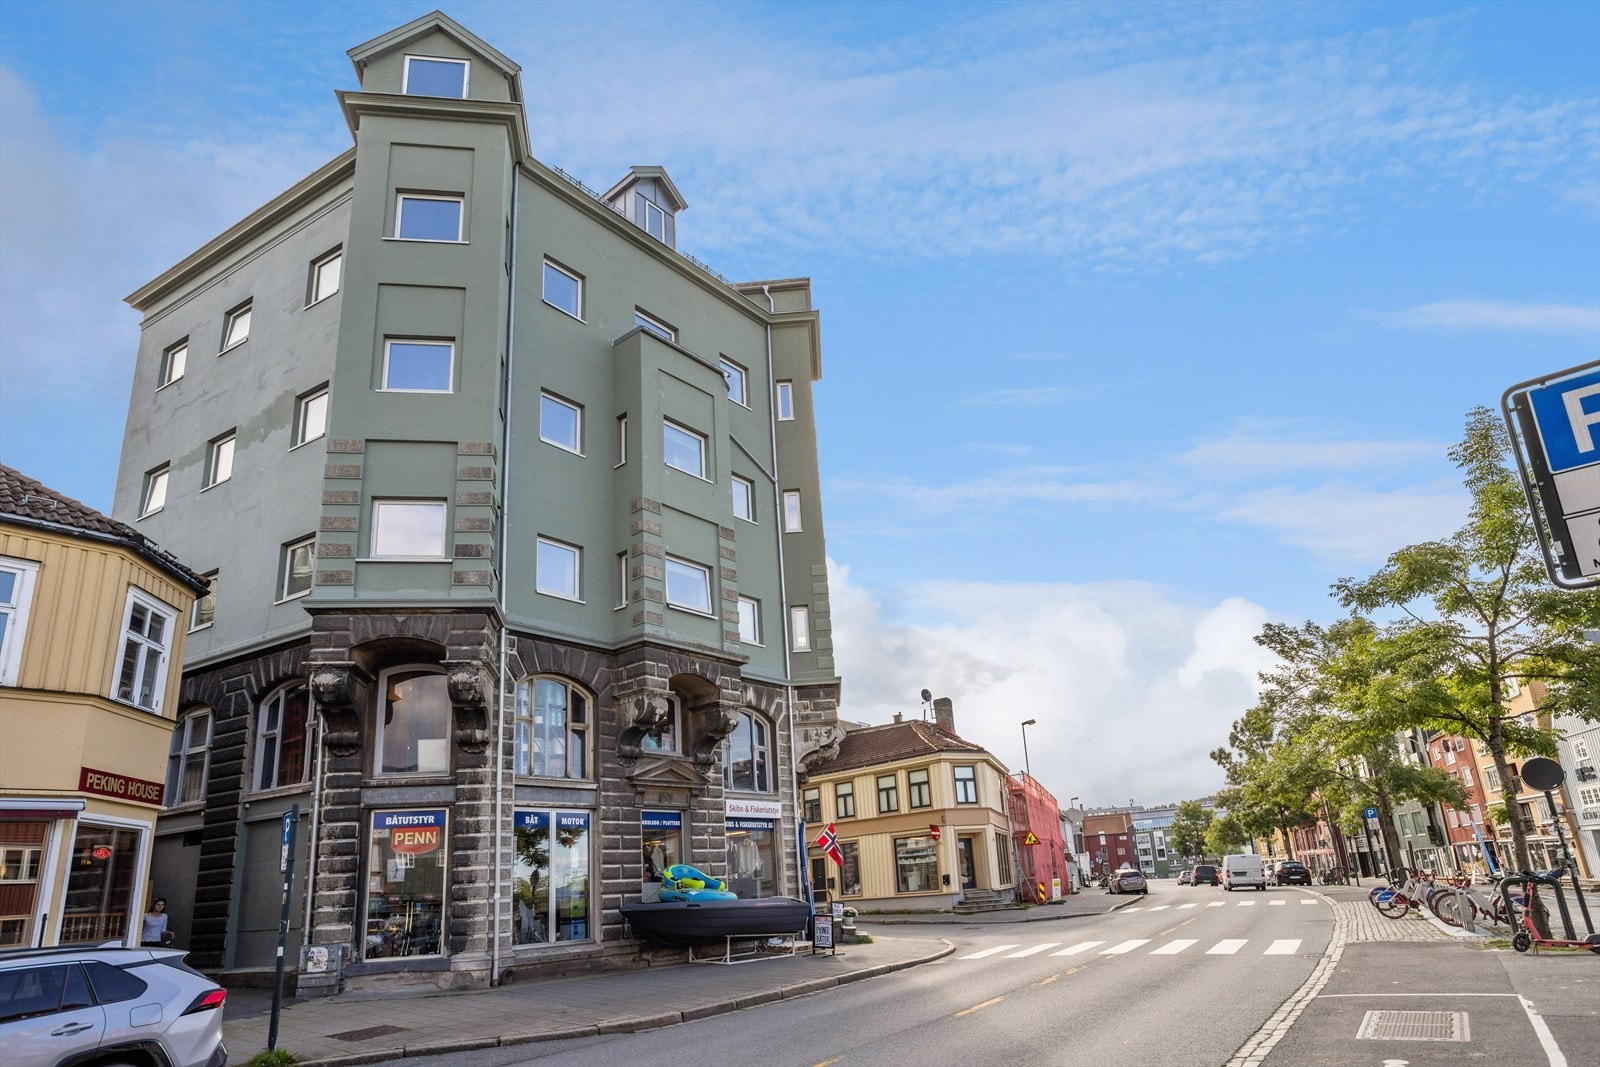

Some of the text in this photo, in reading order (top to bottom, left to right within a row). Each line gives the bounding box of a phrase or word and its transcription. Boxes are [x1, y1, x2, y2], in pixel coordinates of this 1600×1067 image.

[86, 772, 160, 800] PEKING HOUSE
[525, 814, 539, 824] BÅT
[1367, 809, 1374, 818] P
[385, 814, 435, 825] BÅTUTSTYR
[561, 817, 584, 826] MOTOR
[284, 818, 291, 841] P
[394, 831, 436, 845] PENN
